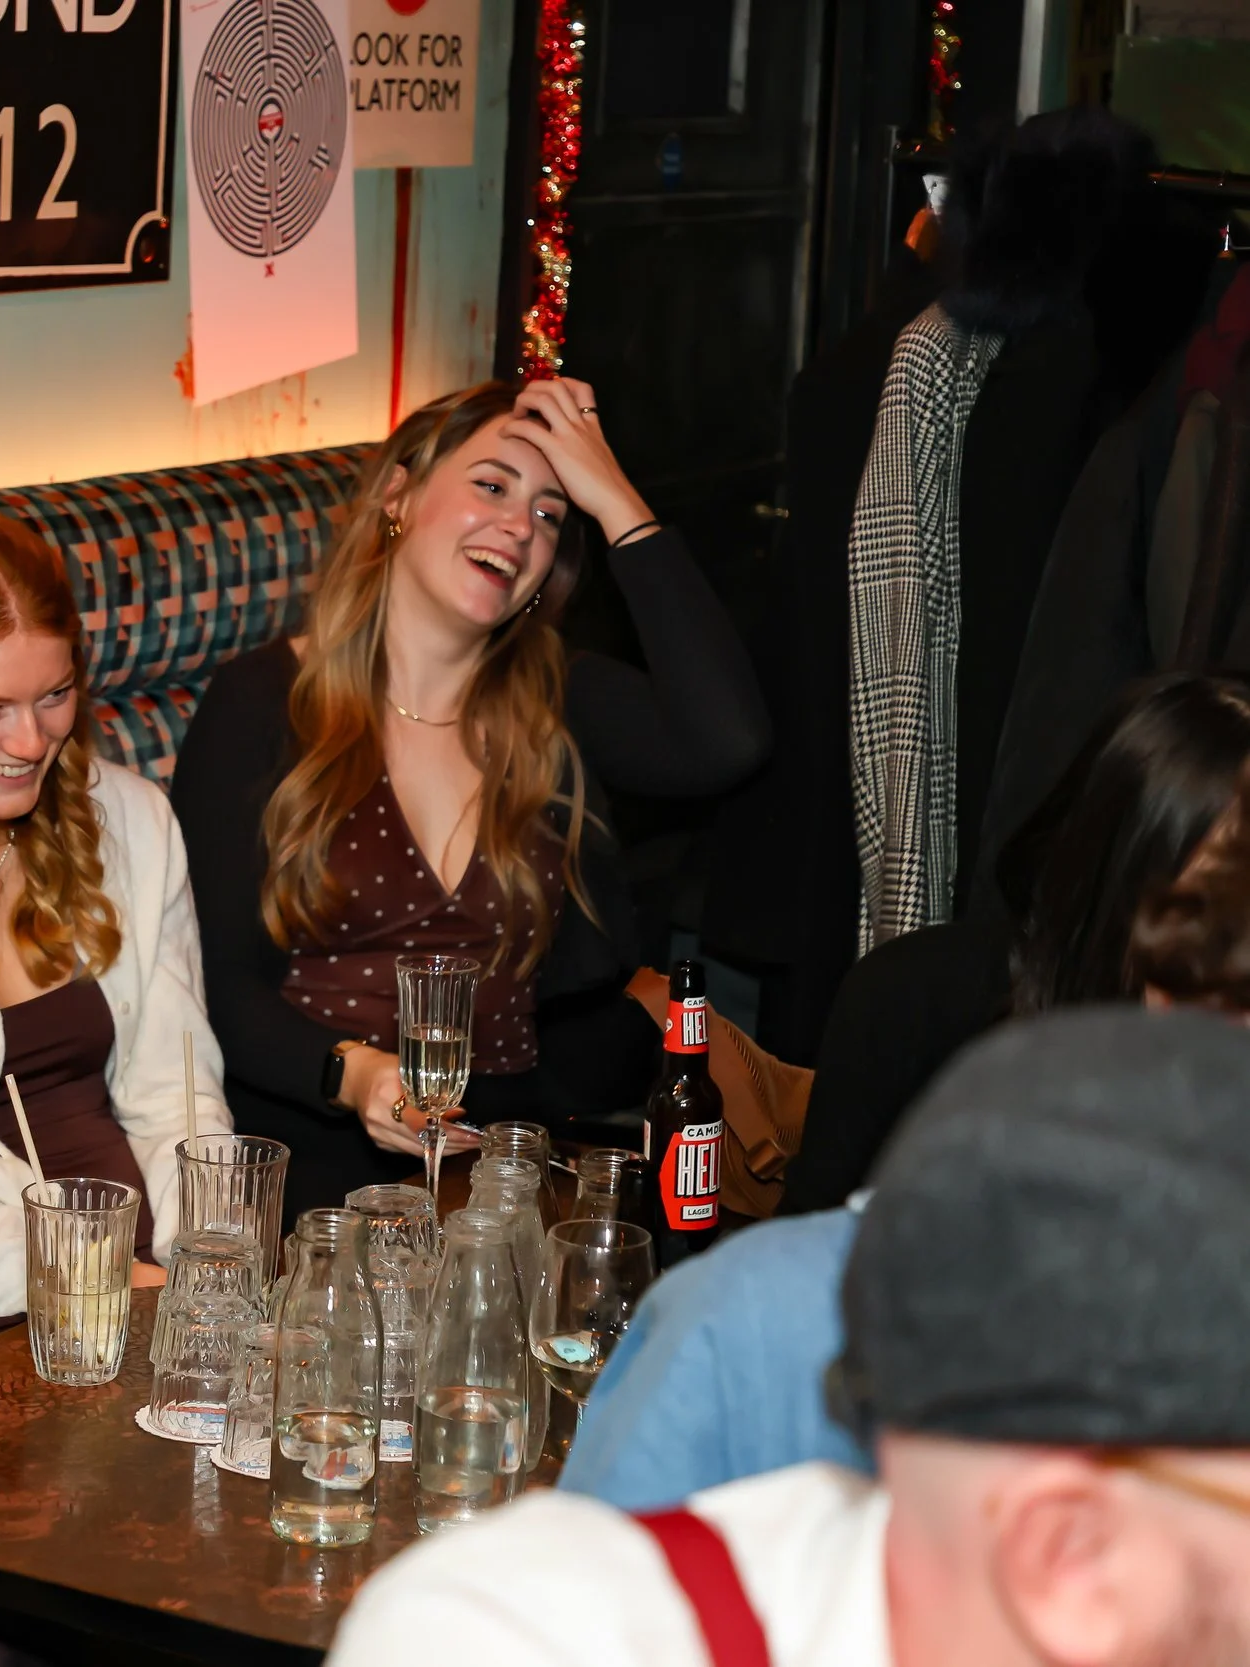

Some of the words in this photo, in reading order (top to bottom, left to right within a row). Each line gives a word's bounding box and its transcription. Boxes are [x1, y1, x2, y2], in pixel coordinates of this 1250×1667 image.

[350, 31, 409, 66] OOK
[418, 33, 463, 68] FOR
[37, 103, 79, 220] 2
[687, 1207, 710, 1216] LAGER
